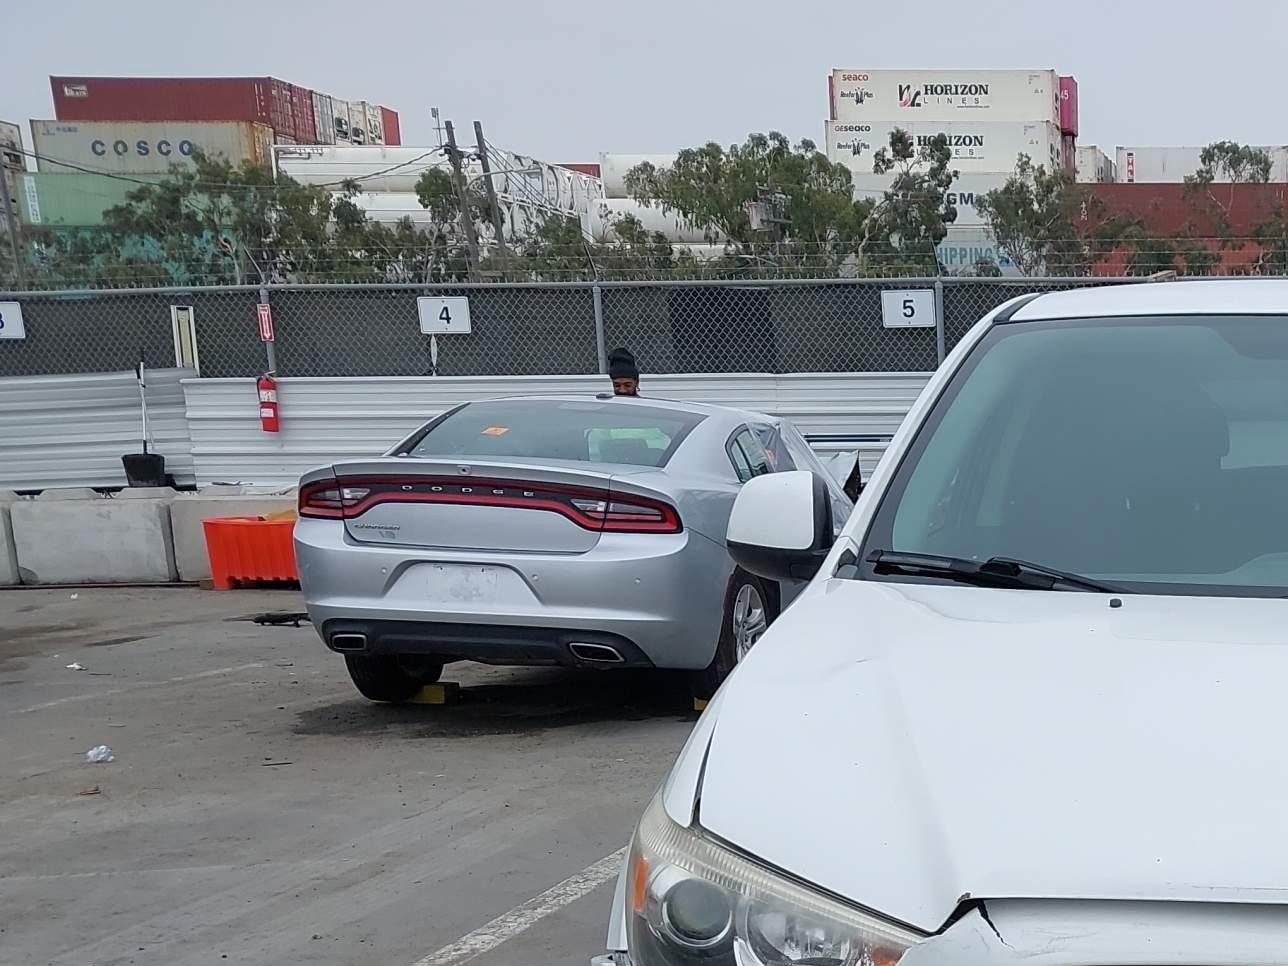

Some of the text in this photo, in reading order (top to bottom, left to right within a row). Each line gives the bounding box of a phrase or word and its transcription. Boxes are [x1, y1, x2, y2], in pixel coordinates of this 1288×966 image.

[841, 73, 869, 82] seaco
[923, 84, 989, 96] HORIZON
[91, 139, 193, 156] COSCO
[916, 135, 984, 147] HOIZON
[439, 306, 452, 324] 4
[903, 299, 915, 318] 5
[402, 484, 534, 497] DODGE
